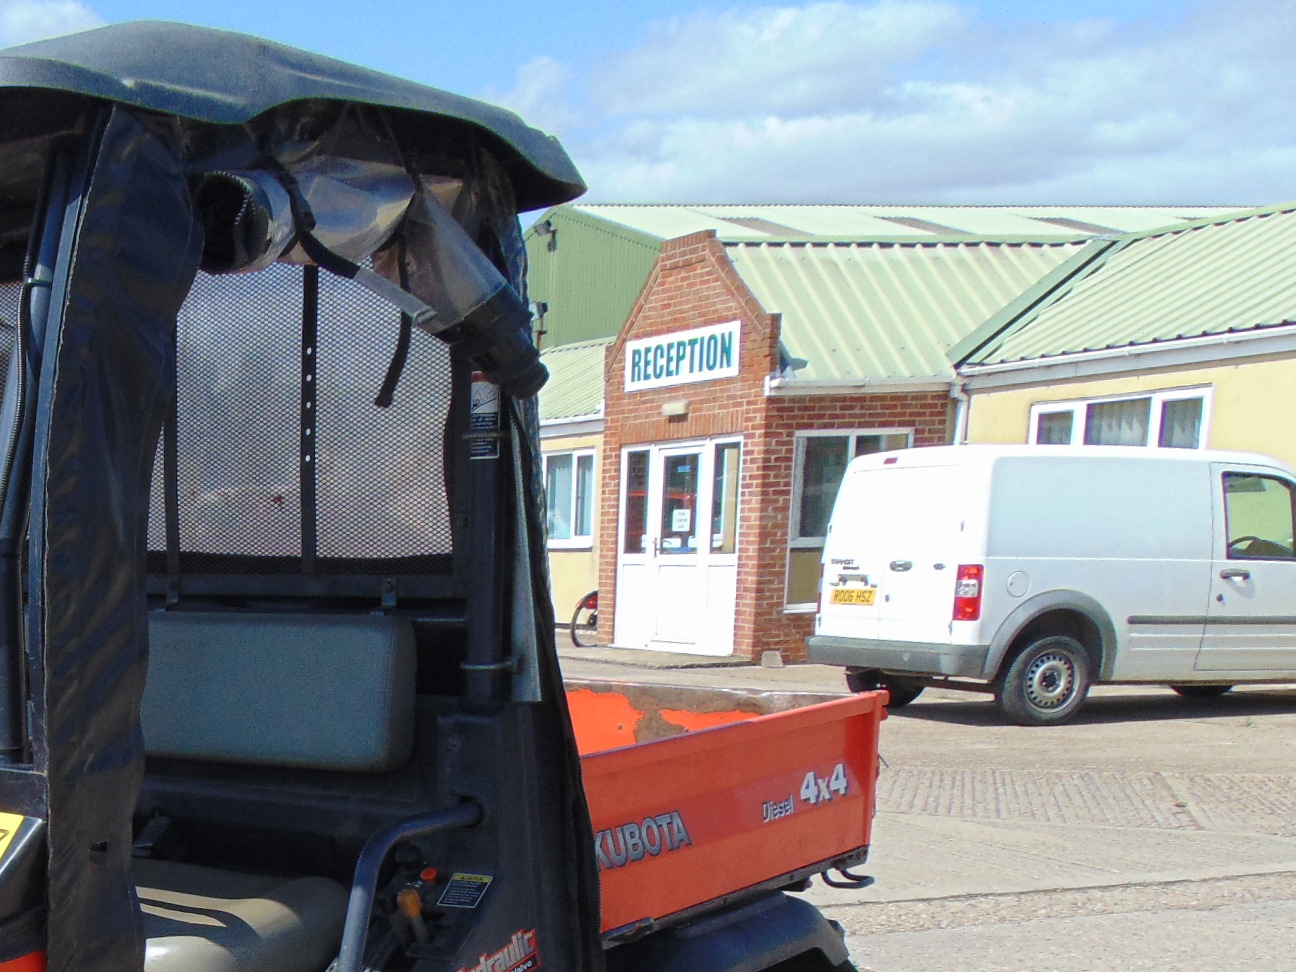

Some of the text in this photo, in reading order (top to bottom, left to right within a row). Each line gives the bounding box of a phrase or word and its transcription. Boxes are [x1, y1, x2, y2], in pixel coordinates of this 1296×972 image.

[631, 331, 733, 382] RECEPTION
[762, 763, 848, 823] Diesel 4x4
[594, 809, 692, 872] KUBOTA
